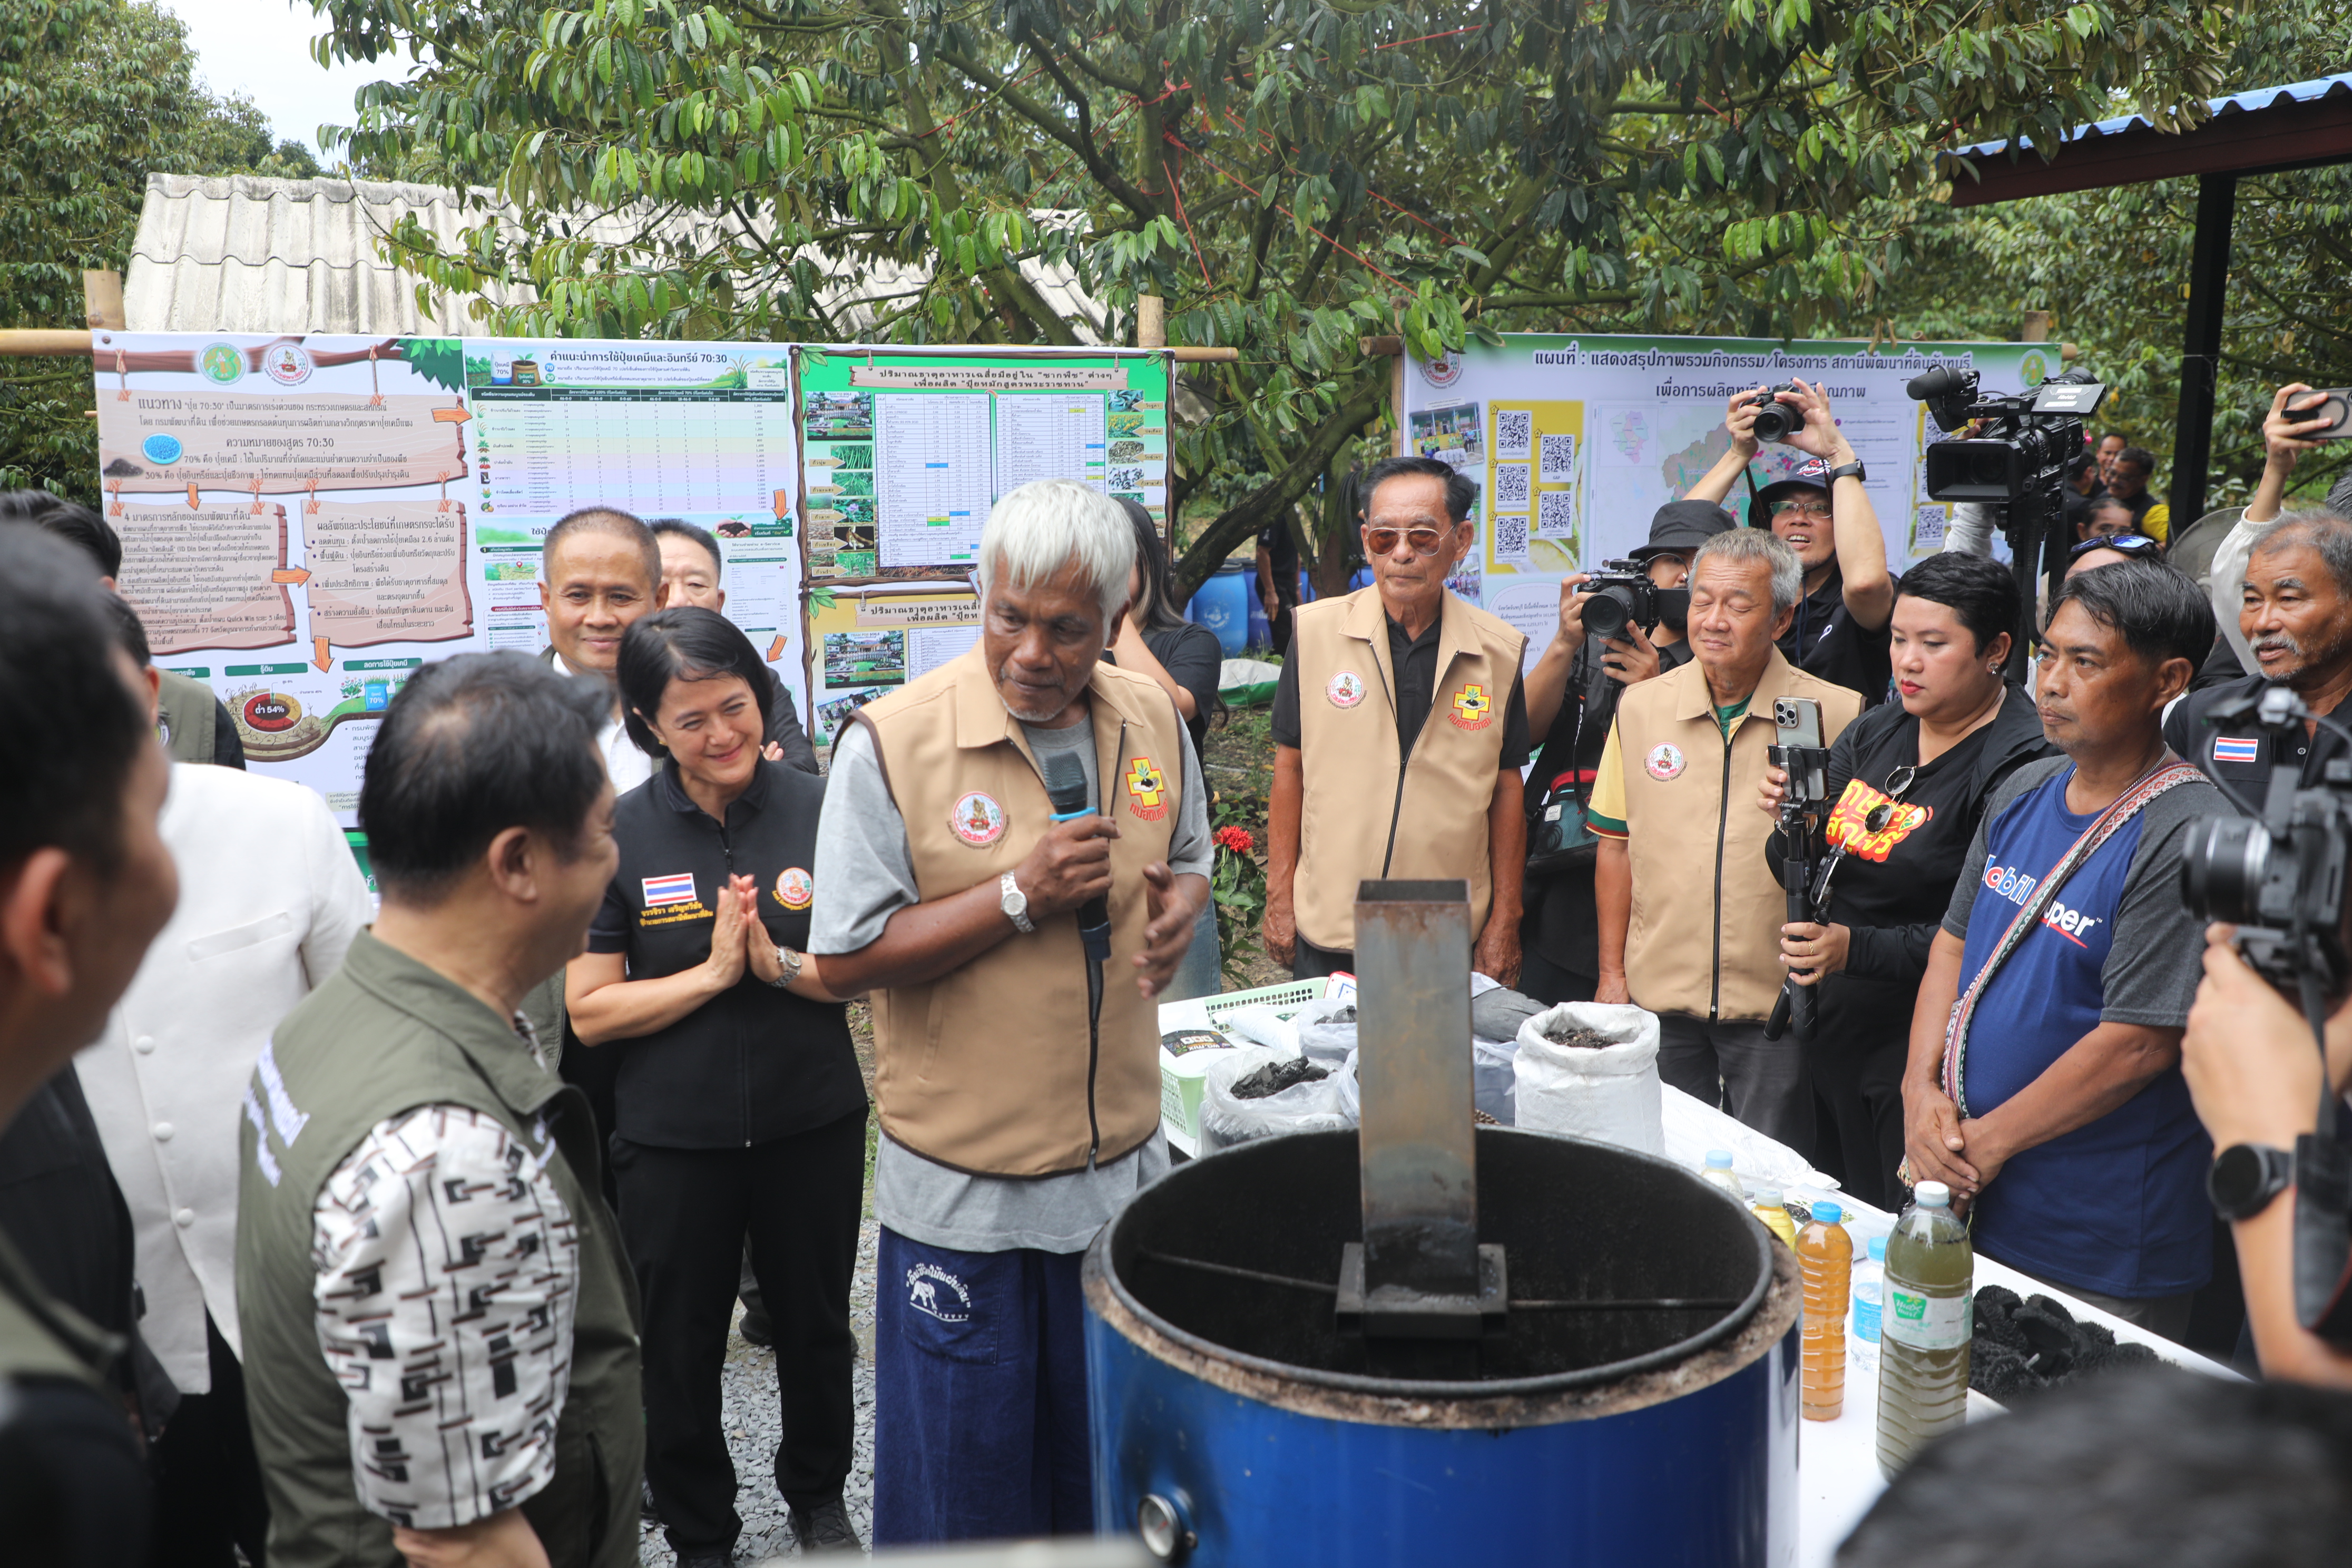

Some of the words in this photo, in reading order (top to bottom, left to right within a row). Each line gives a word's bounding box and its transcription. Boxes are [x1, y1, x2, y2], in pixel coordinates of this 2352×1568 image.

[550, 350, 698, 365] คำแนะนำการใช้ปุ๋ยเคมีและอินทรีย์
[700, 354, 728, 363] 70:30
[1535, 344, 1576, 365] แผนที่
[1591, 350, 1827, 370] แสดงสรุปภาพรวมกิจกรรม/โครงการ
[271, 376, 297, 387] Development
[1088, 371, 1112, 380] ต่างๆ
[914, 377, 957, 387] เพื่อผลิต
[1424, 377, 1448, 389] Development
[138, 398, 182, 410] แนวทาง
[227, 398, 304, 411] เป็นมาตรการเร่งด่วนของ
[306, 400, 387, 411] กระทรวงเกษตรและสหกรณ์
[139, 415, 153, 426] โดย
[155, 414, 206, 426] กรมพัฒนาที่ดิน
[226, 438, 304, 450] ความหมายของสูตร
[307, 438, 335, 447] 70:30
[203, 454, 213, 463] คือ
[215, 452, 237, 465] ปุ๋ยเคมี
[164, 471, 175, 479] คือ
[177, 467, 254, 482] ปุ๋ยอินทรีย์และปุ๋ยชีวภาพ
[124, 513, 130, 521] 4
[132, 507, 250, 521] มาตรการหลักของกรมพัฒนาที่ดิน
[317, 515, 455, 531] ผลลัพธ์และประโยชน์ที่เกษตรกรจะได้รับ
[318, 534, 345, 546] ลดต้นทุน
[434, 533, 455, 543] ล้านตัน
[352, 562, 389, 573] โครงสร้างดิน
[322, 577, 369, 588] เพิ่มประสิทธิภาพ
[375, 575, 448, 588] พืชได้รับธาตุอาหารที่สมดุล
[376, 589, 425, 602] และตรงจุดมากขึ้น
[324, 605, 369, 616] สร้างความยั่งยืน
[376, 604, 433, 615] ป้องกันปัญหาดินดาน
[907, 613, 948, 622] เพื่อผลิต
[376, 619, 435, 629] เสื่อมโทรมในระยะยาว
[260, 664, 273, 674] รู้ดิน
[364, 659, 408, 669] ลดการใช้ปุ๋ยเคมี
[267, 705, 285, 714] 54%
[1645, 769, 1669, 782] Development
[2043, 900, 2095, 937] uper
